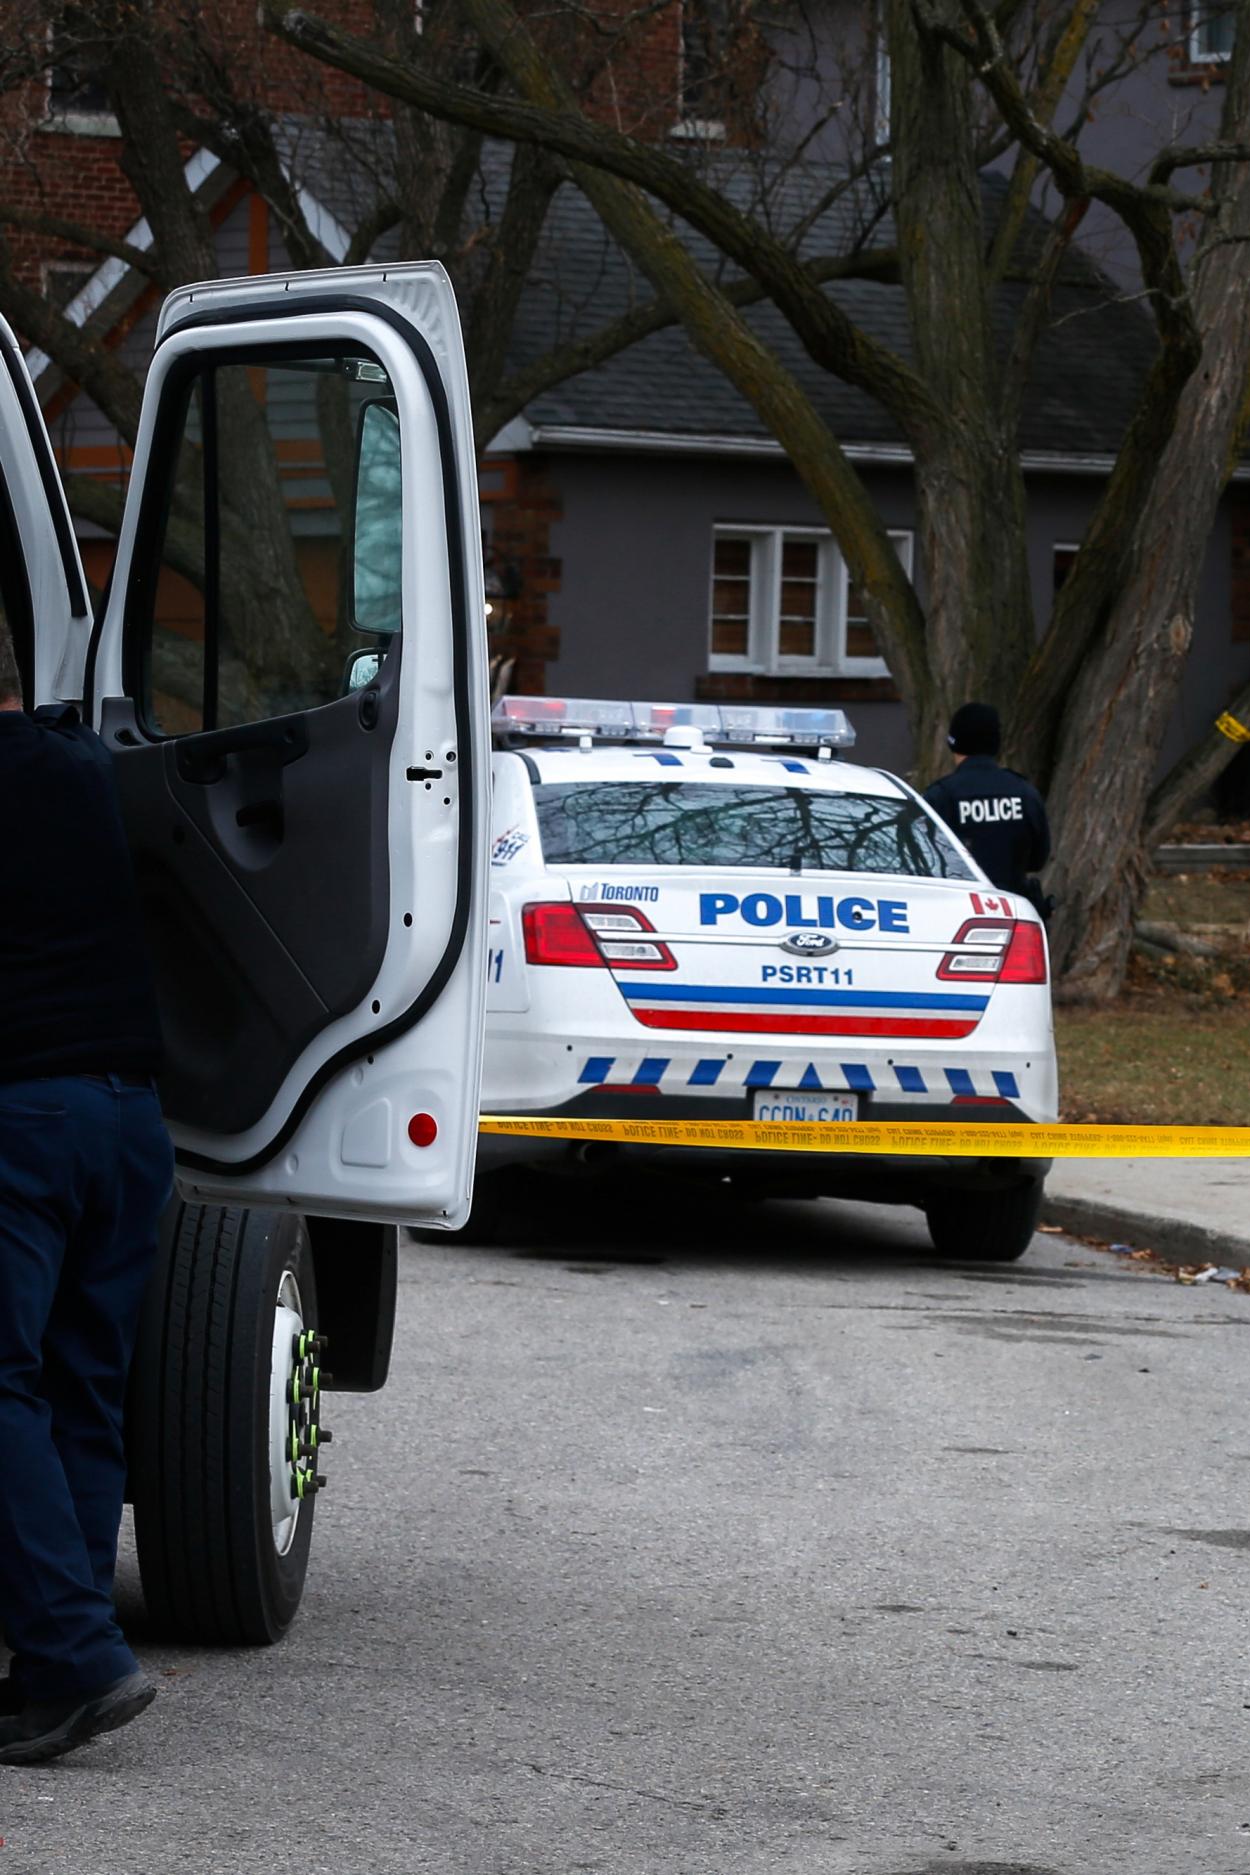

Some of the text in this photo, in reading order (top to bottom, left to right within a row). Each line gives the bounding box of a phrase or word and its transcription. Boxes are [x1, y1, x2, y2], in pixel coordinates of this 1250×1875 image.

[959, 797, 1023, 824] POLICE
[601, 883, 659, 902] TORONTO
[699, 893, 910, 933] POLICE
[796, 934, 825, 947] Ford
[762, 965, 853, 985] PSRT11
